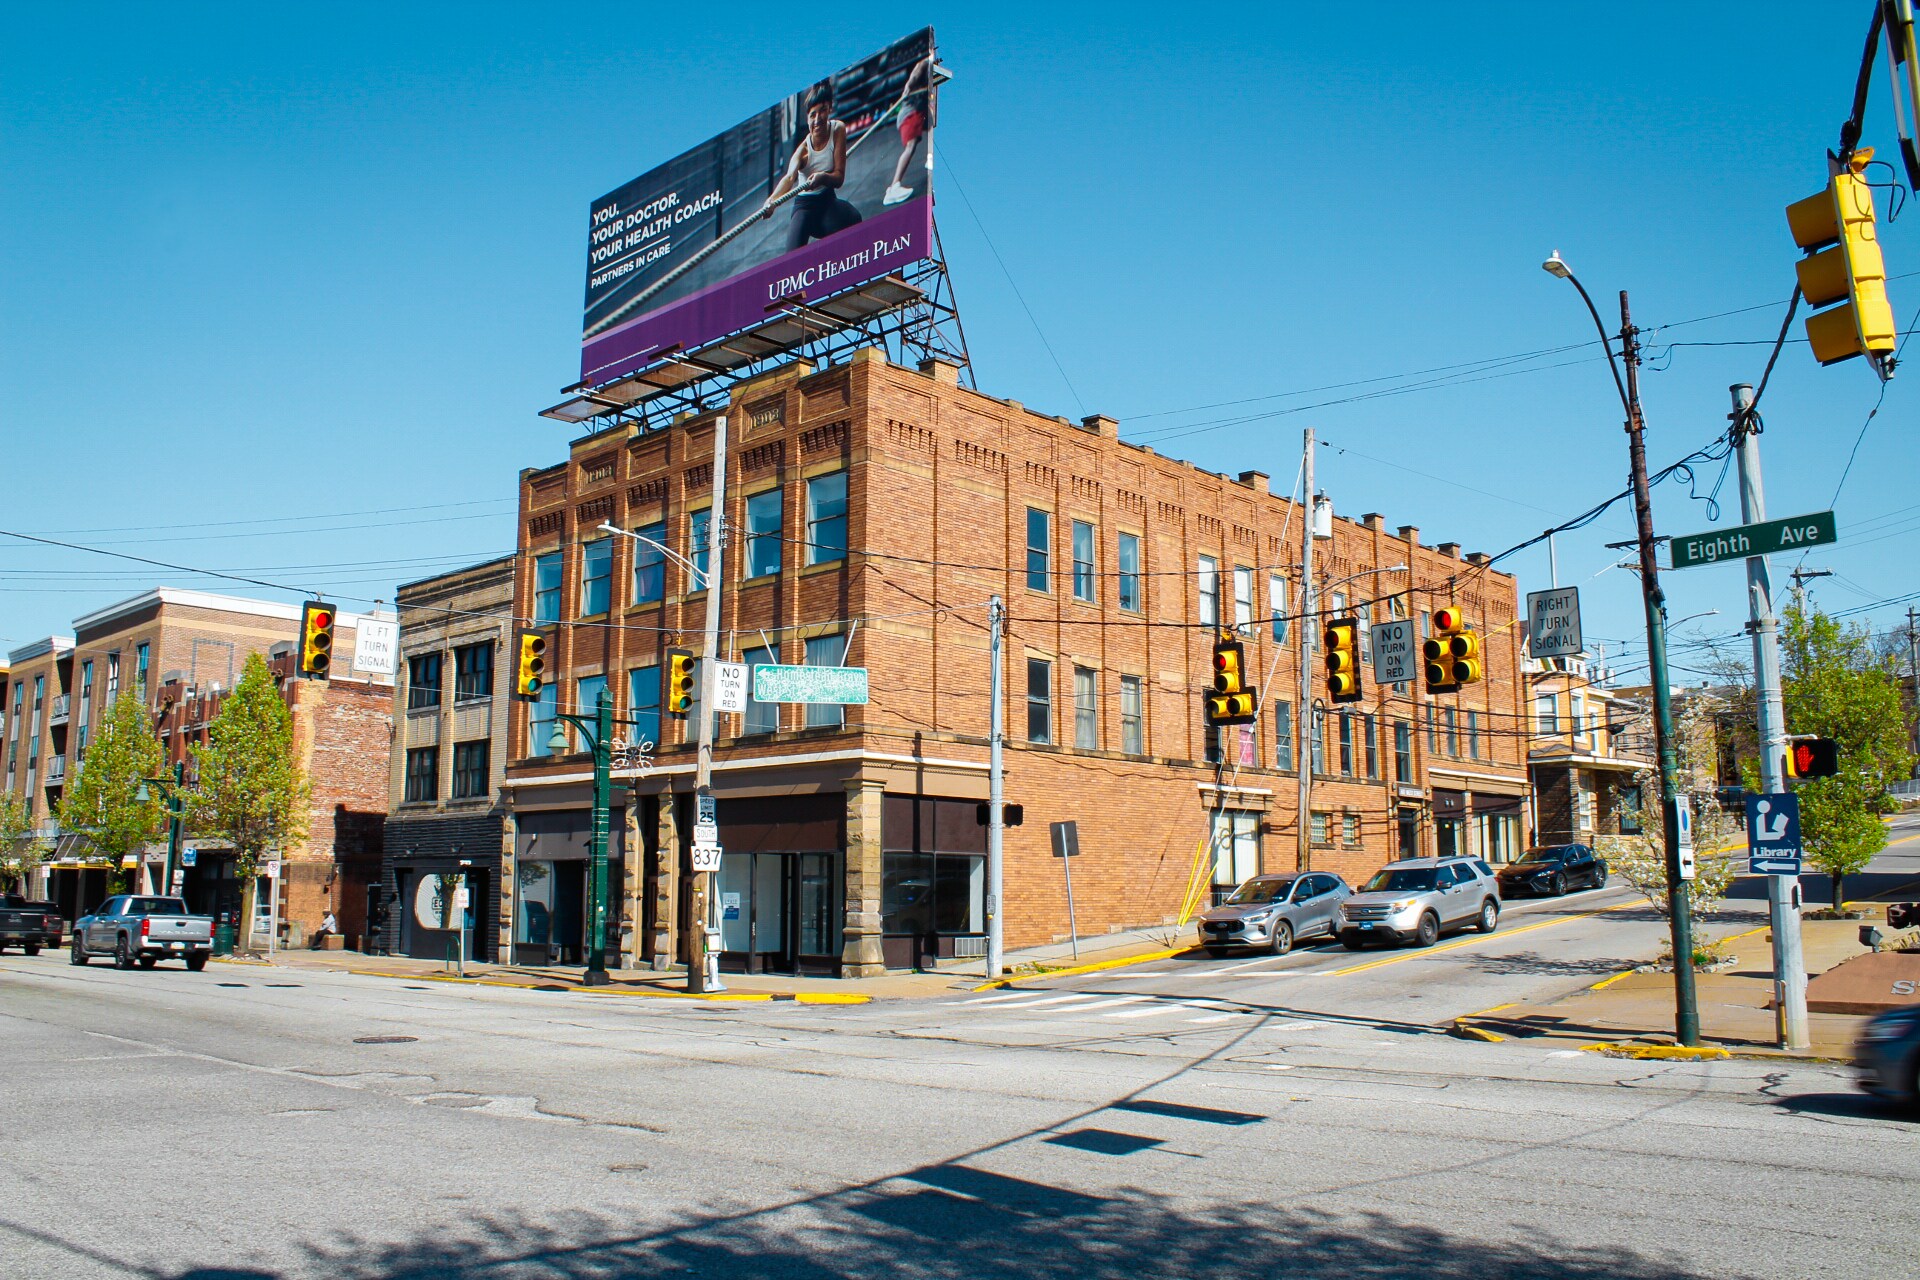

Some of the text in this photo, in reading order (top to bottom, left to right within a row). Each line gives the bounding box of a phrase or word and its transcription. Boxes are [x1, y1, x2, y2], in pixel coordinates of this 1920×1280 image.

[592, 192, 680, 245] YOUR DOCTOR.
[593, 203, 620, 226] YOU.
[591, 190, 723, 265] YOUR HEALTH COACH.
[591, 243, 671, 289] PARTNERS IN CARE
[768, 267, 815, 300] UPMC
[1687, 524, 1819, 561] Eighth Ave
[1536, 596, 1570, 612] RIGHT
[1539, 615, 1570, 630] TURN
[367, 626, 389, 638] LFT
[1382, 626, 1403, 642] NO
[364, 640, 389, 653] TURN
[1380, 642, 1406, 655] TURN
[1535, 634, 1577, 650] SIGNAL
[358, 655, 391, 669] SIGNAL
[1387, 655, 1401, 666] ON
[722, 667, 740, 679] NO
[1386, 667, 1404, 678] RED
[720, 679, 740, 689] TURN
[724, 689, 735, 698] ON
[722, 699, 737, 708] RED
[699, 811, 714, 823] 25
[696, 828, 716, 838] SOUTH
[693, 848, 721, 865] 837
[1753, 846, 1797, 859] Library
